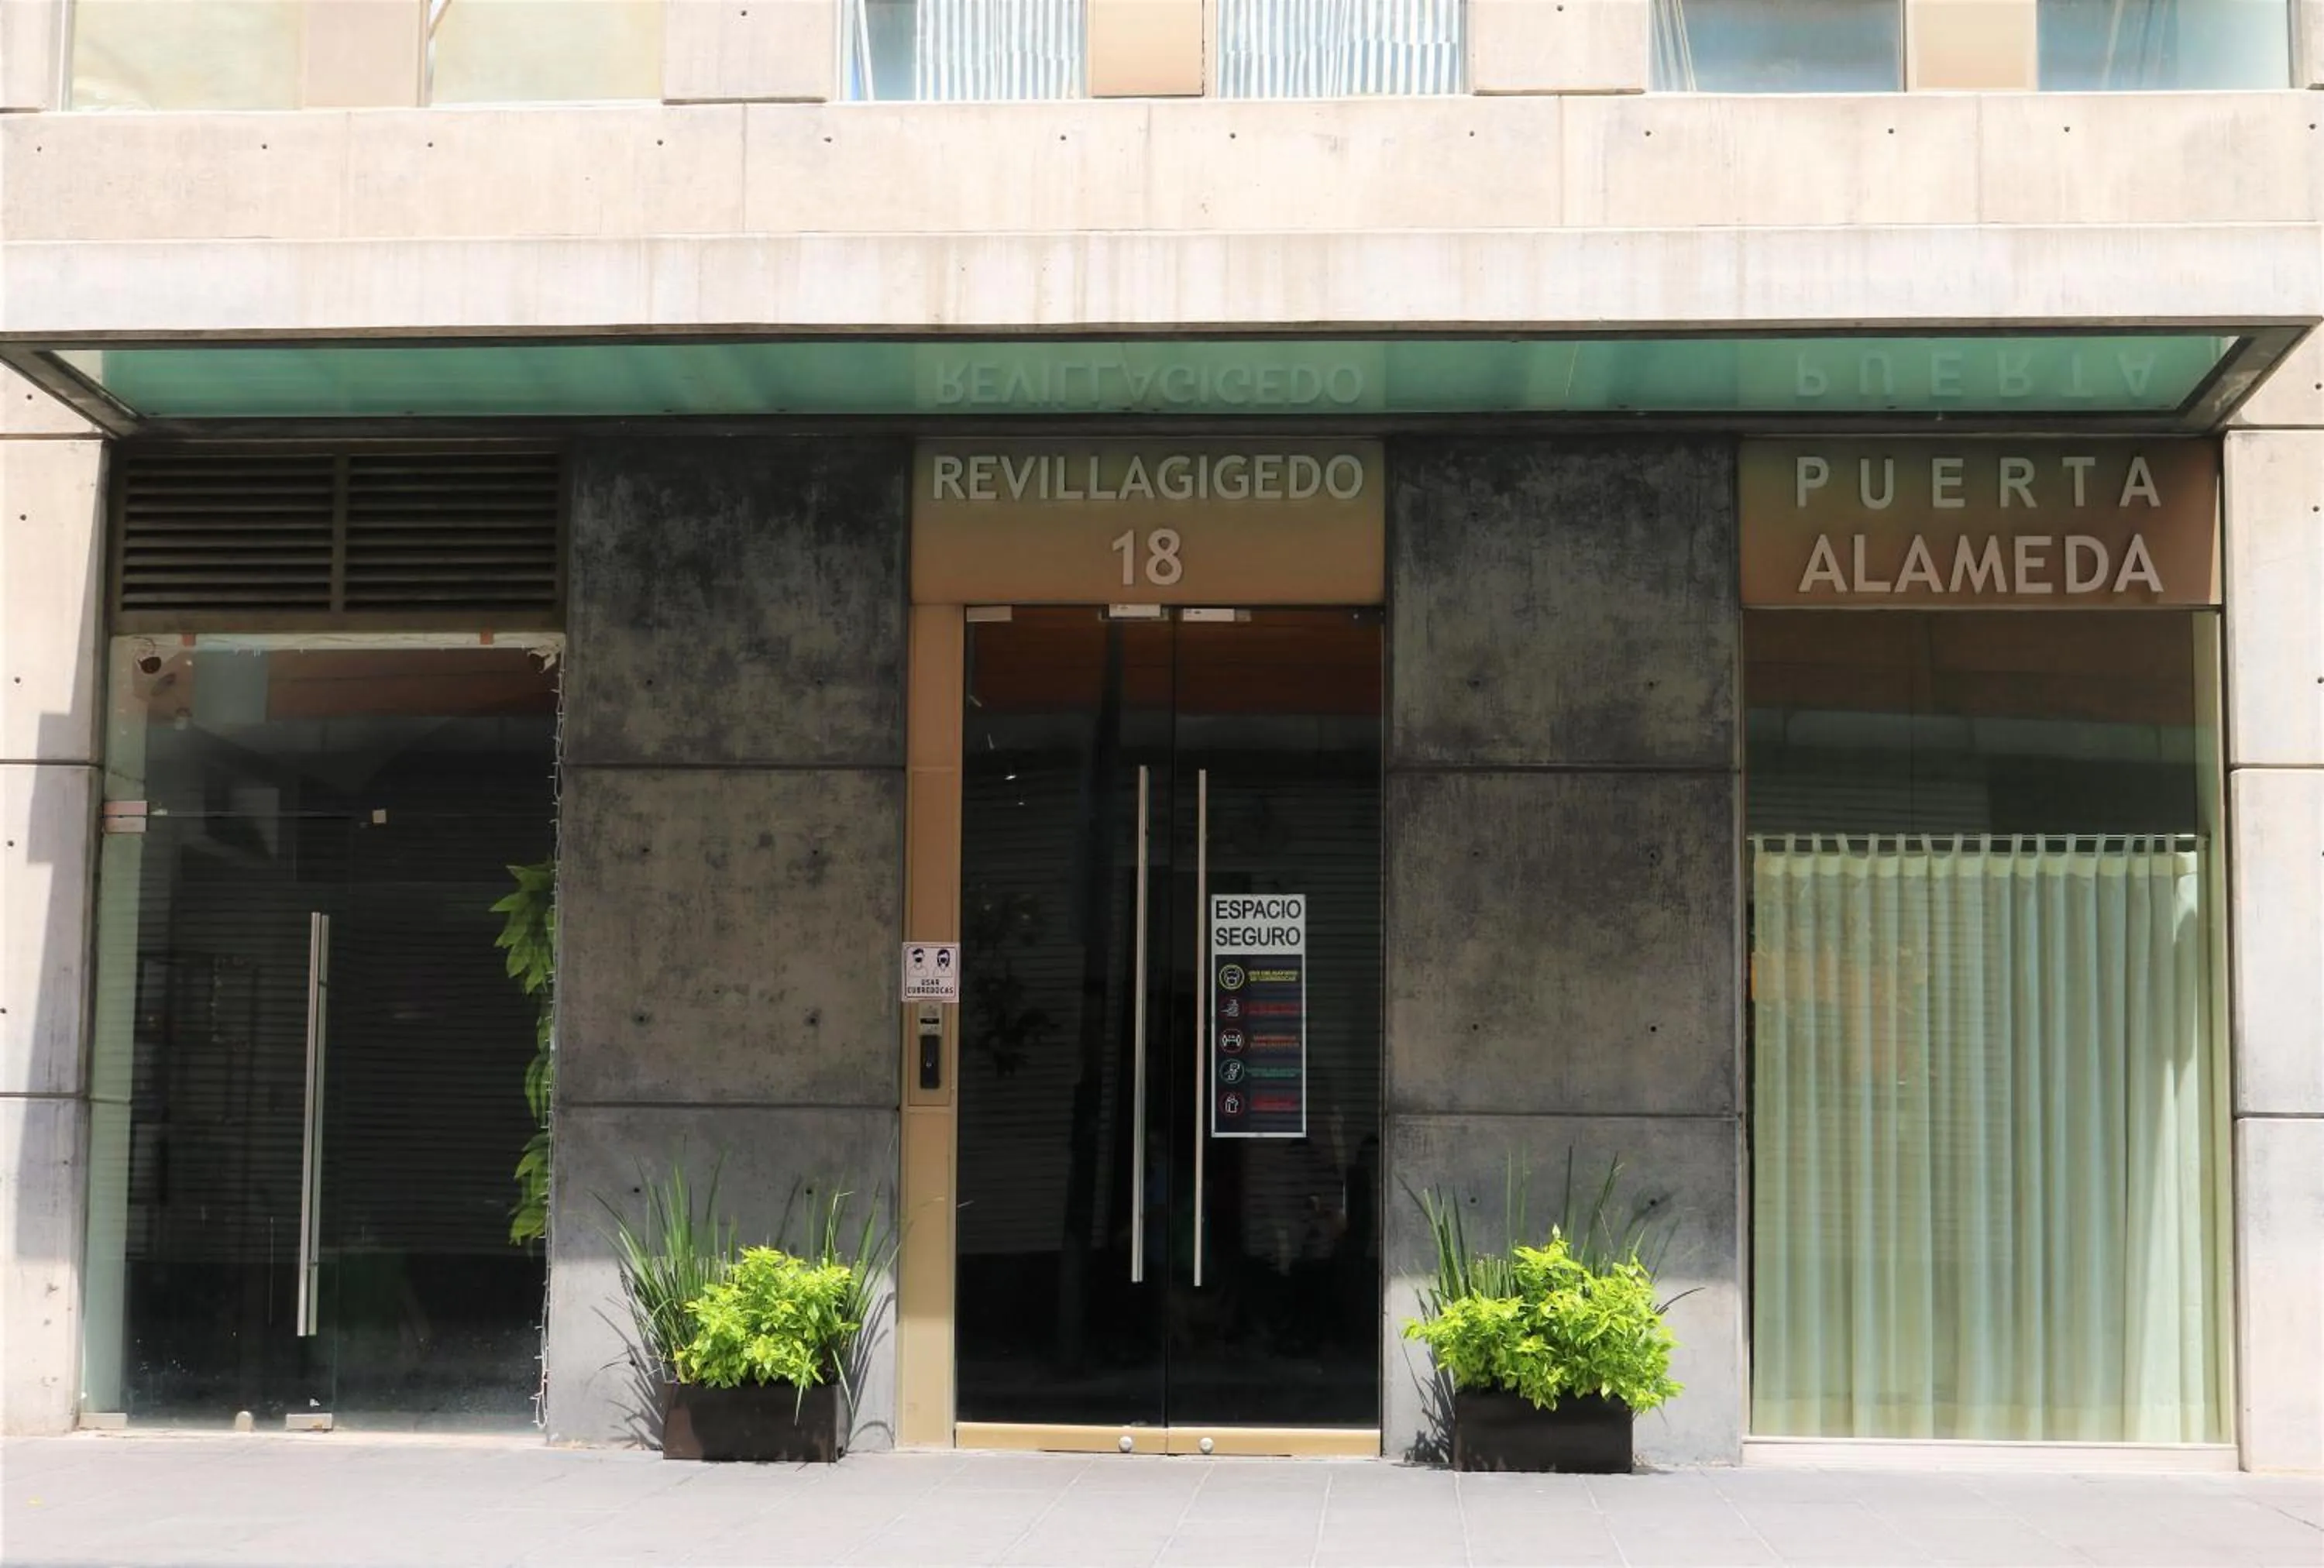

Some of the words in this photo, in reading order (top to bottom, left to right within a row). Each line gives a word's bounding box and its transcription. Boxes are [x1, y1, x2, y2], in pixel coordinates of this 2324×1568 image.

[933, 454, 1363, 500] REVILLAGIGEDO
[1796, 456, 2161, 510] PUERTA
[1112, 528, 1183, 586] 18
[1797, 533, 2164, 593] ALAMEDA
[1215, 899, 1301, 920] ESPACIO
[1215, 927, 1301, 947] SEGURO
